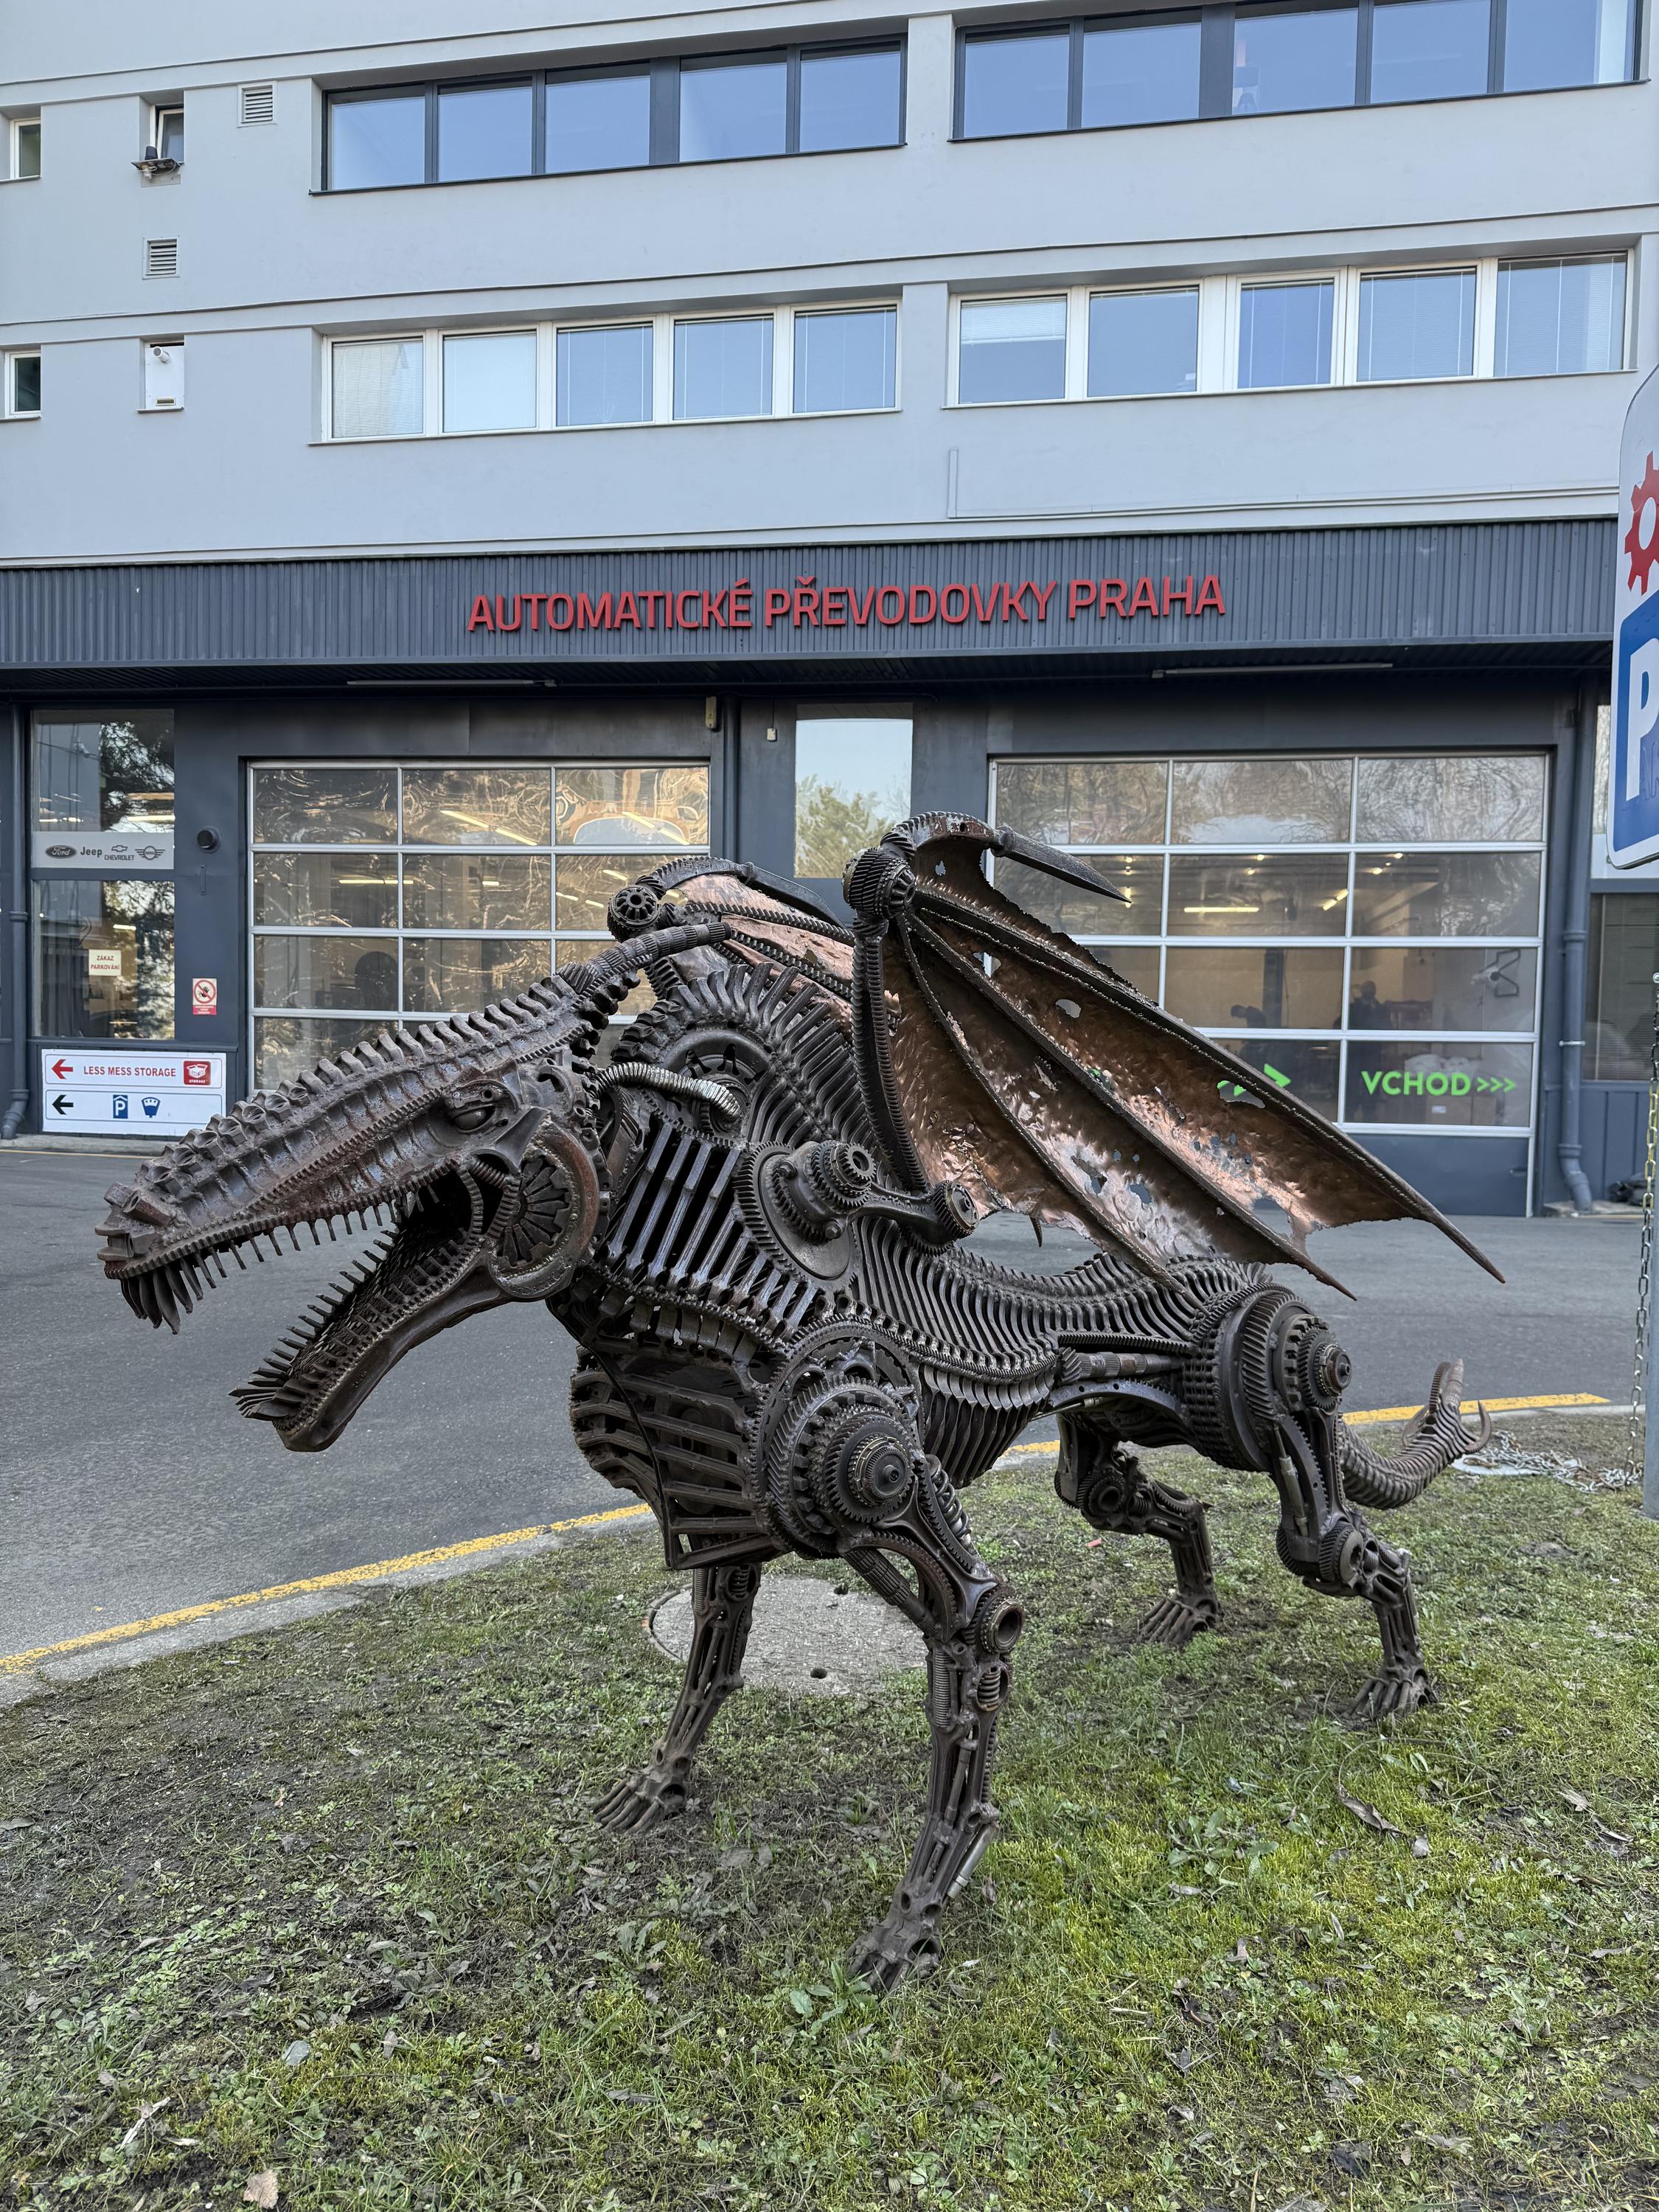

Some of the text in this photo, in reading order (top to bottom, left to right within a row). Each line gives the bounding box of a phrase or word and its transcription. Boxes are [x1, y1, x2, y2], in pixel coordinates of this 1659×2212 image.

[467, 574, 1226, 633] AUTOMATICKÉ PŘEVODOVKY PRAHA
[1626, 638, 1659, 802] P
[52, 846, 71, 856] Ford
[80, 846, 102, 858] Jeep
[83, 1066, 176, 1077] LESS MESS STORAGE
[1361, 1071, 1471, 1096] VCHOD
[115, 1100, 126, 1116] P
